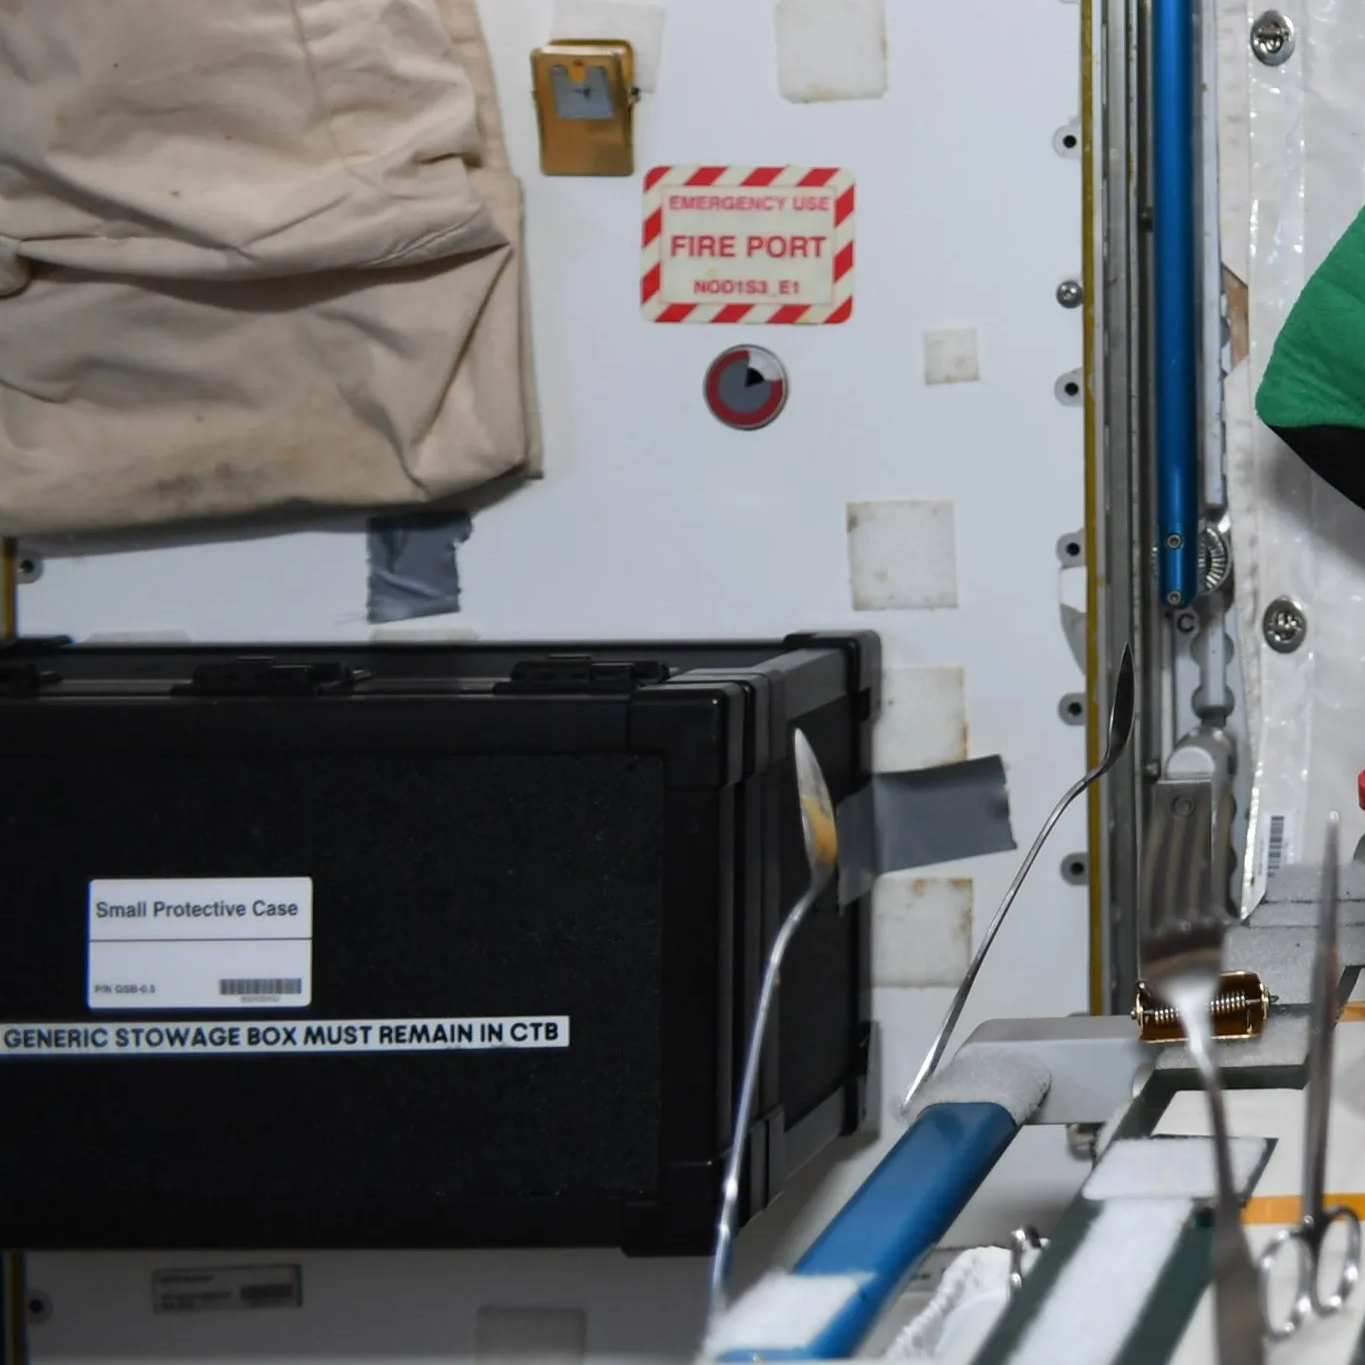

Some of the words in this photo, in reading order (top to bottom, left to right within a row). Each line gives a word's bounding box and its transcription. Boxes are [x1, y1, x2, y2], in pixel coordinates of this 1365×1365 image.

[668, 195, 787, 211] EMERGENCY
[792, 196, 830, 211] USE
[670, 235, 736, 258] FIRE
[746, 235, 827, 258] PORT
[1177, 613, 1195, 634] C
[95, 900, 147, 919] Small
[152, 899, 247, 918] Protective
[252, 899, 299, 917] Case
[3, 1027, 109, 1049] GENERIC
[115, 1026, 241, 1048] STOWAGE
[246, 1025, 298, 1047] BOX
[303, 1025, 373, 1046] MUST
[378, 1023, 473, 1044] REMAIN
[480, 1023, 503, 1043] IN
[509, 1022, 559, 1042] CTB
